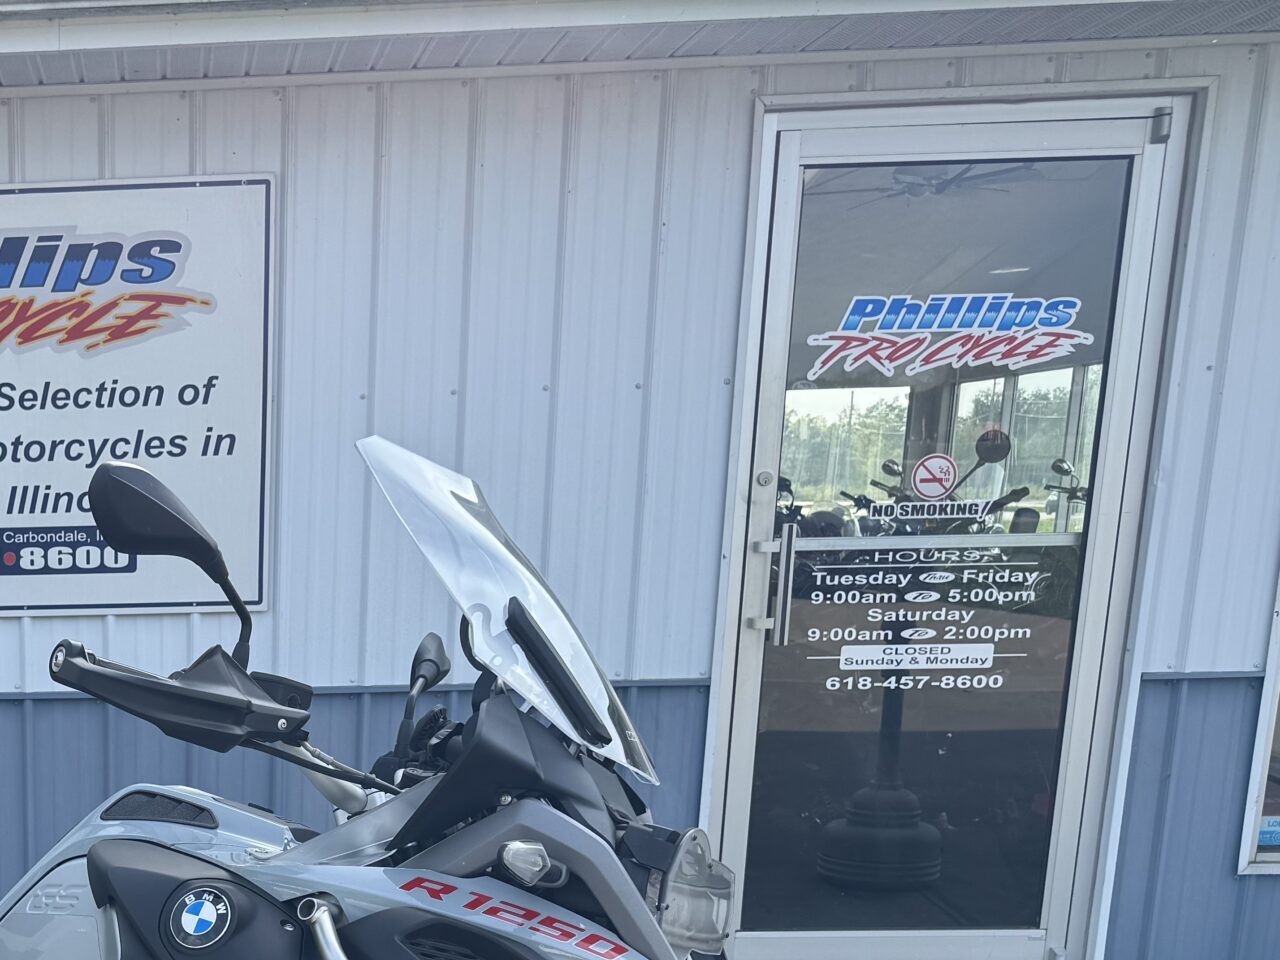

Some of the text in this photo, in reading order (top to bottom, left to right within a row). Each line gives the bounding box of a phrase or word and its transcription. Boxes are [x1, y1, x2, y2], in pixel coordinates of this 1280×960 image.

[839, 294, 1079, 332] Phillips
[812, 331, 1089, 377] PRO CYCLE
[177, 375, 219, 406] of
[201, 426, 237, 457] in
[6, 484, 92, 515] Illino
[871, 500, 993, 520] NO SMOKING!
[3, 529, 91, 544] Carbondale,
[874, 549, 981, 563] HOURS
[812, 570, 913, 588] Tuesday
[962, 568, 1040, 586] Friday
[810, 590, 897, 605] 9:00am
[947, 587, 1036, 605] 5:00pm
[867, 607, 976, 623] Saturday
[807, 628, 893, 642] 9:00am
[943, 625, 1031, 642] 2:00pm
[882, 646, 951, 656] CLOSED
[843, 655, 989, 668] Sunday & Monday
[825, 674, 1004, 691] 618-457-8600
[184, 891, 227, 915] BMW
[399, 876, 630, 960] R 1250
